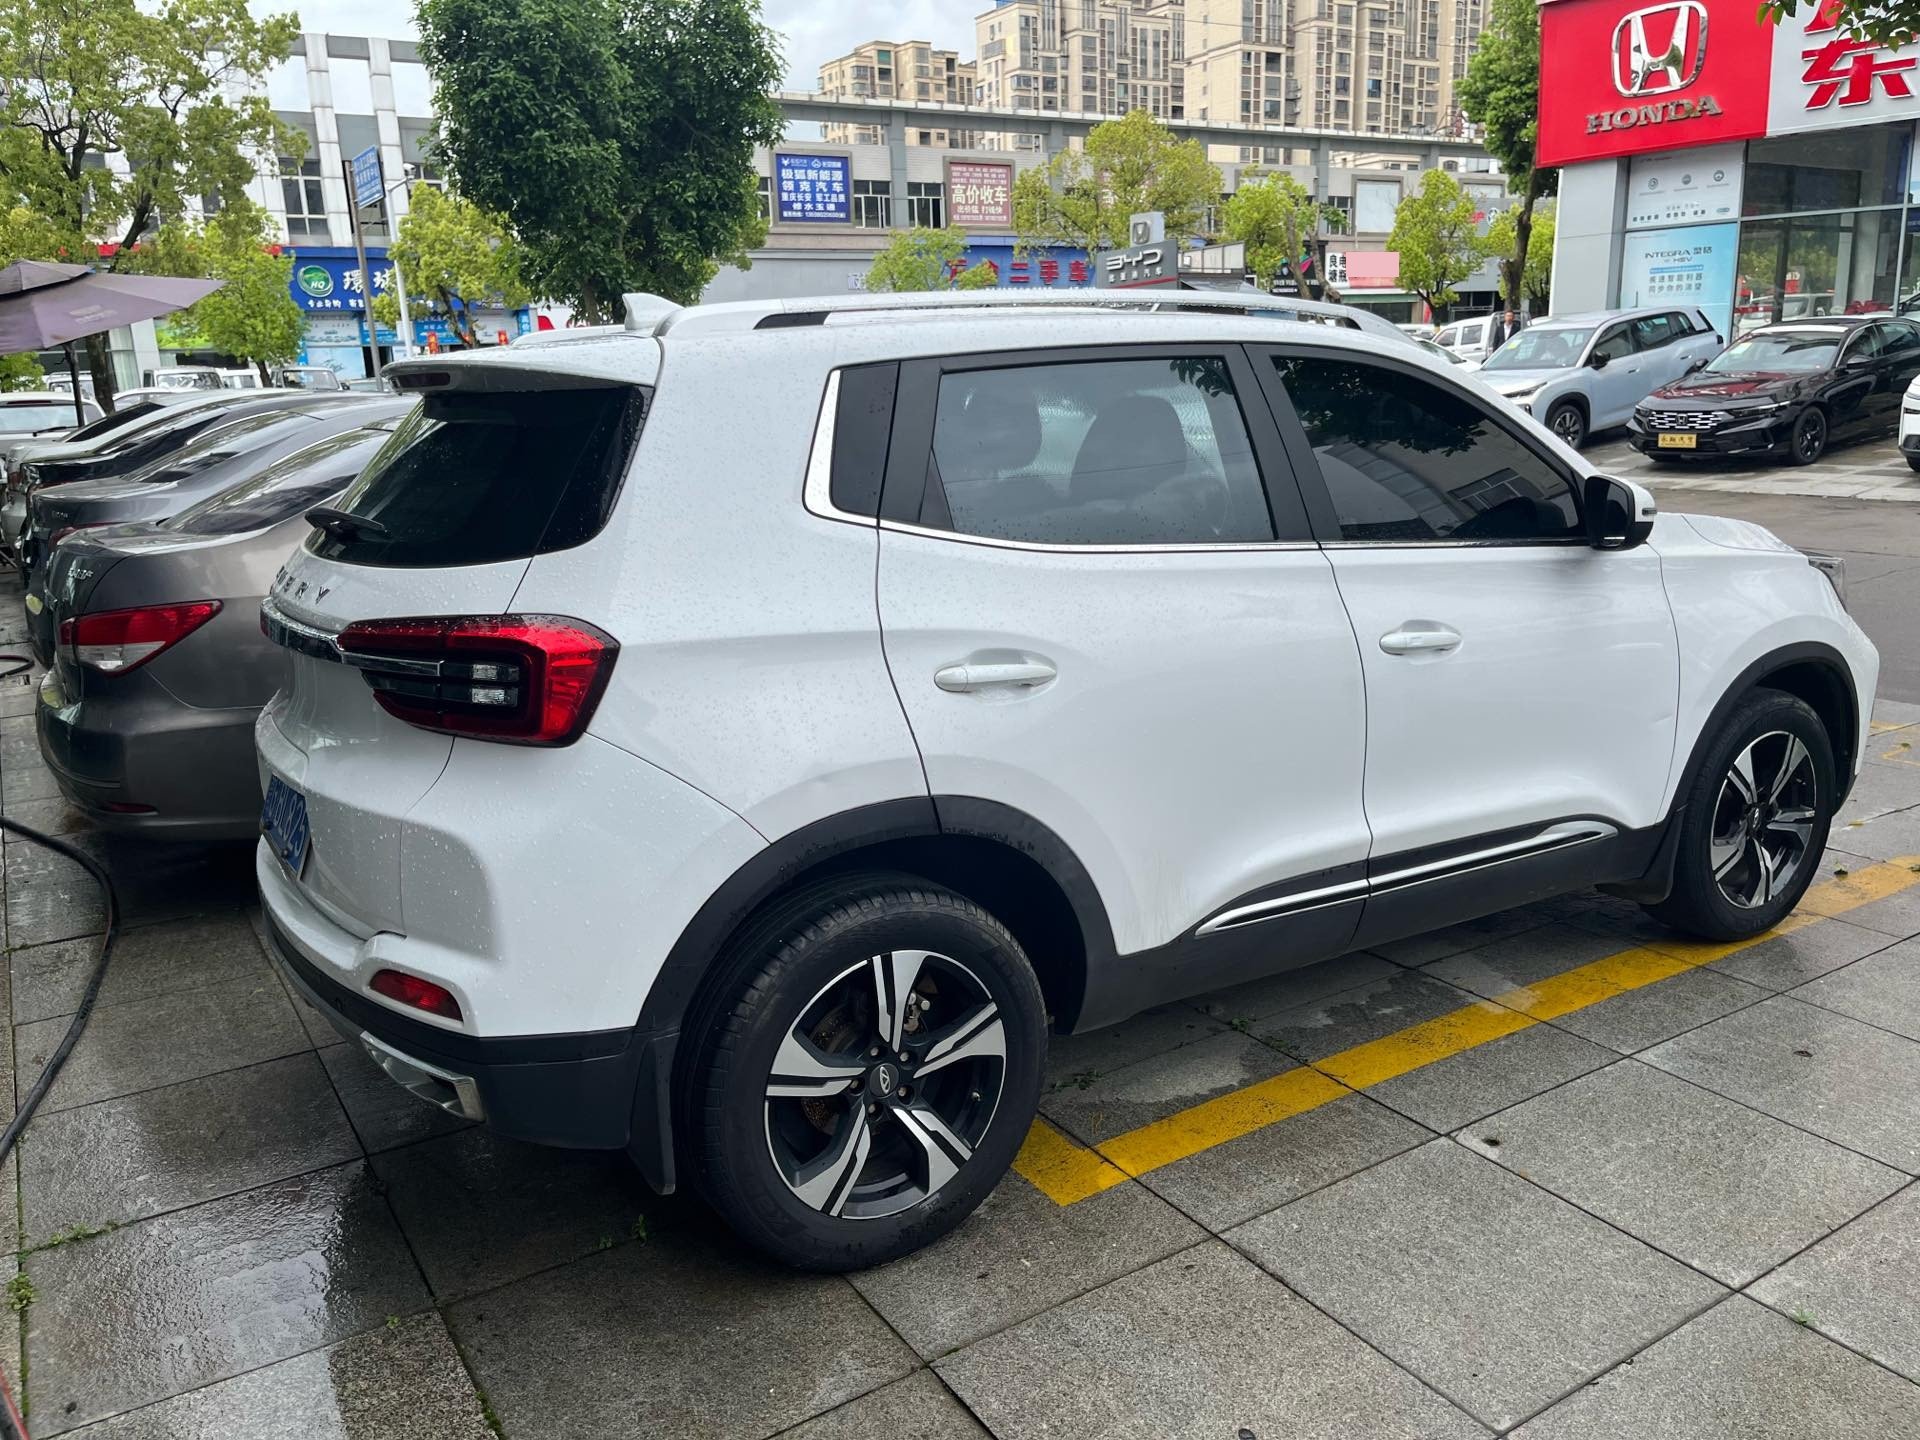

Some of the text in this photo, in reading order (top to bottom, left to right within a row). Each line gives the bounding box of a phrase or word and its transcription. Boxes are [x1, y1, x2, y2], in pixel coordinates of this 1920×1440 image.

[1584, 94, 1723, 135] HONDA
[951, 183, 1008, 205] 高价收车
[1105, 248, 1162, 270] BYD
[1644, 249, 1691, 259] INTEGRA
[310, 280, 326, 289] HQ
